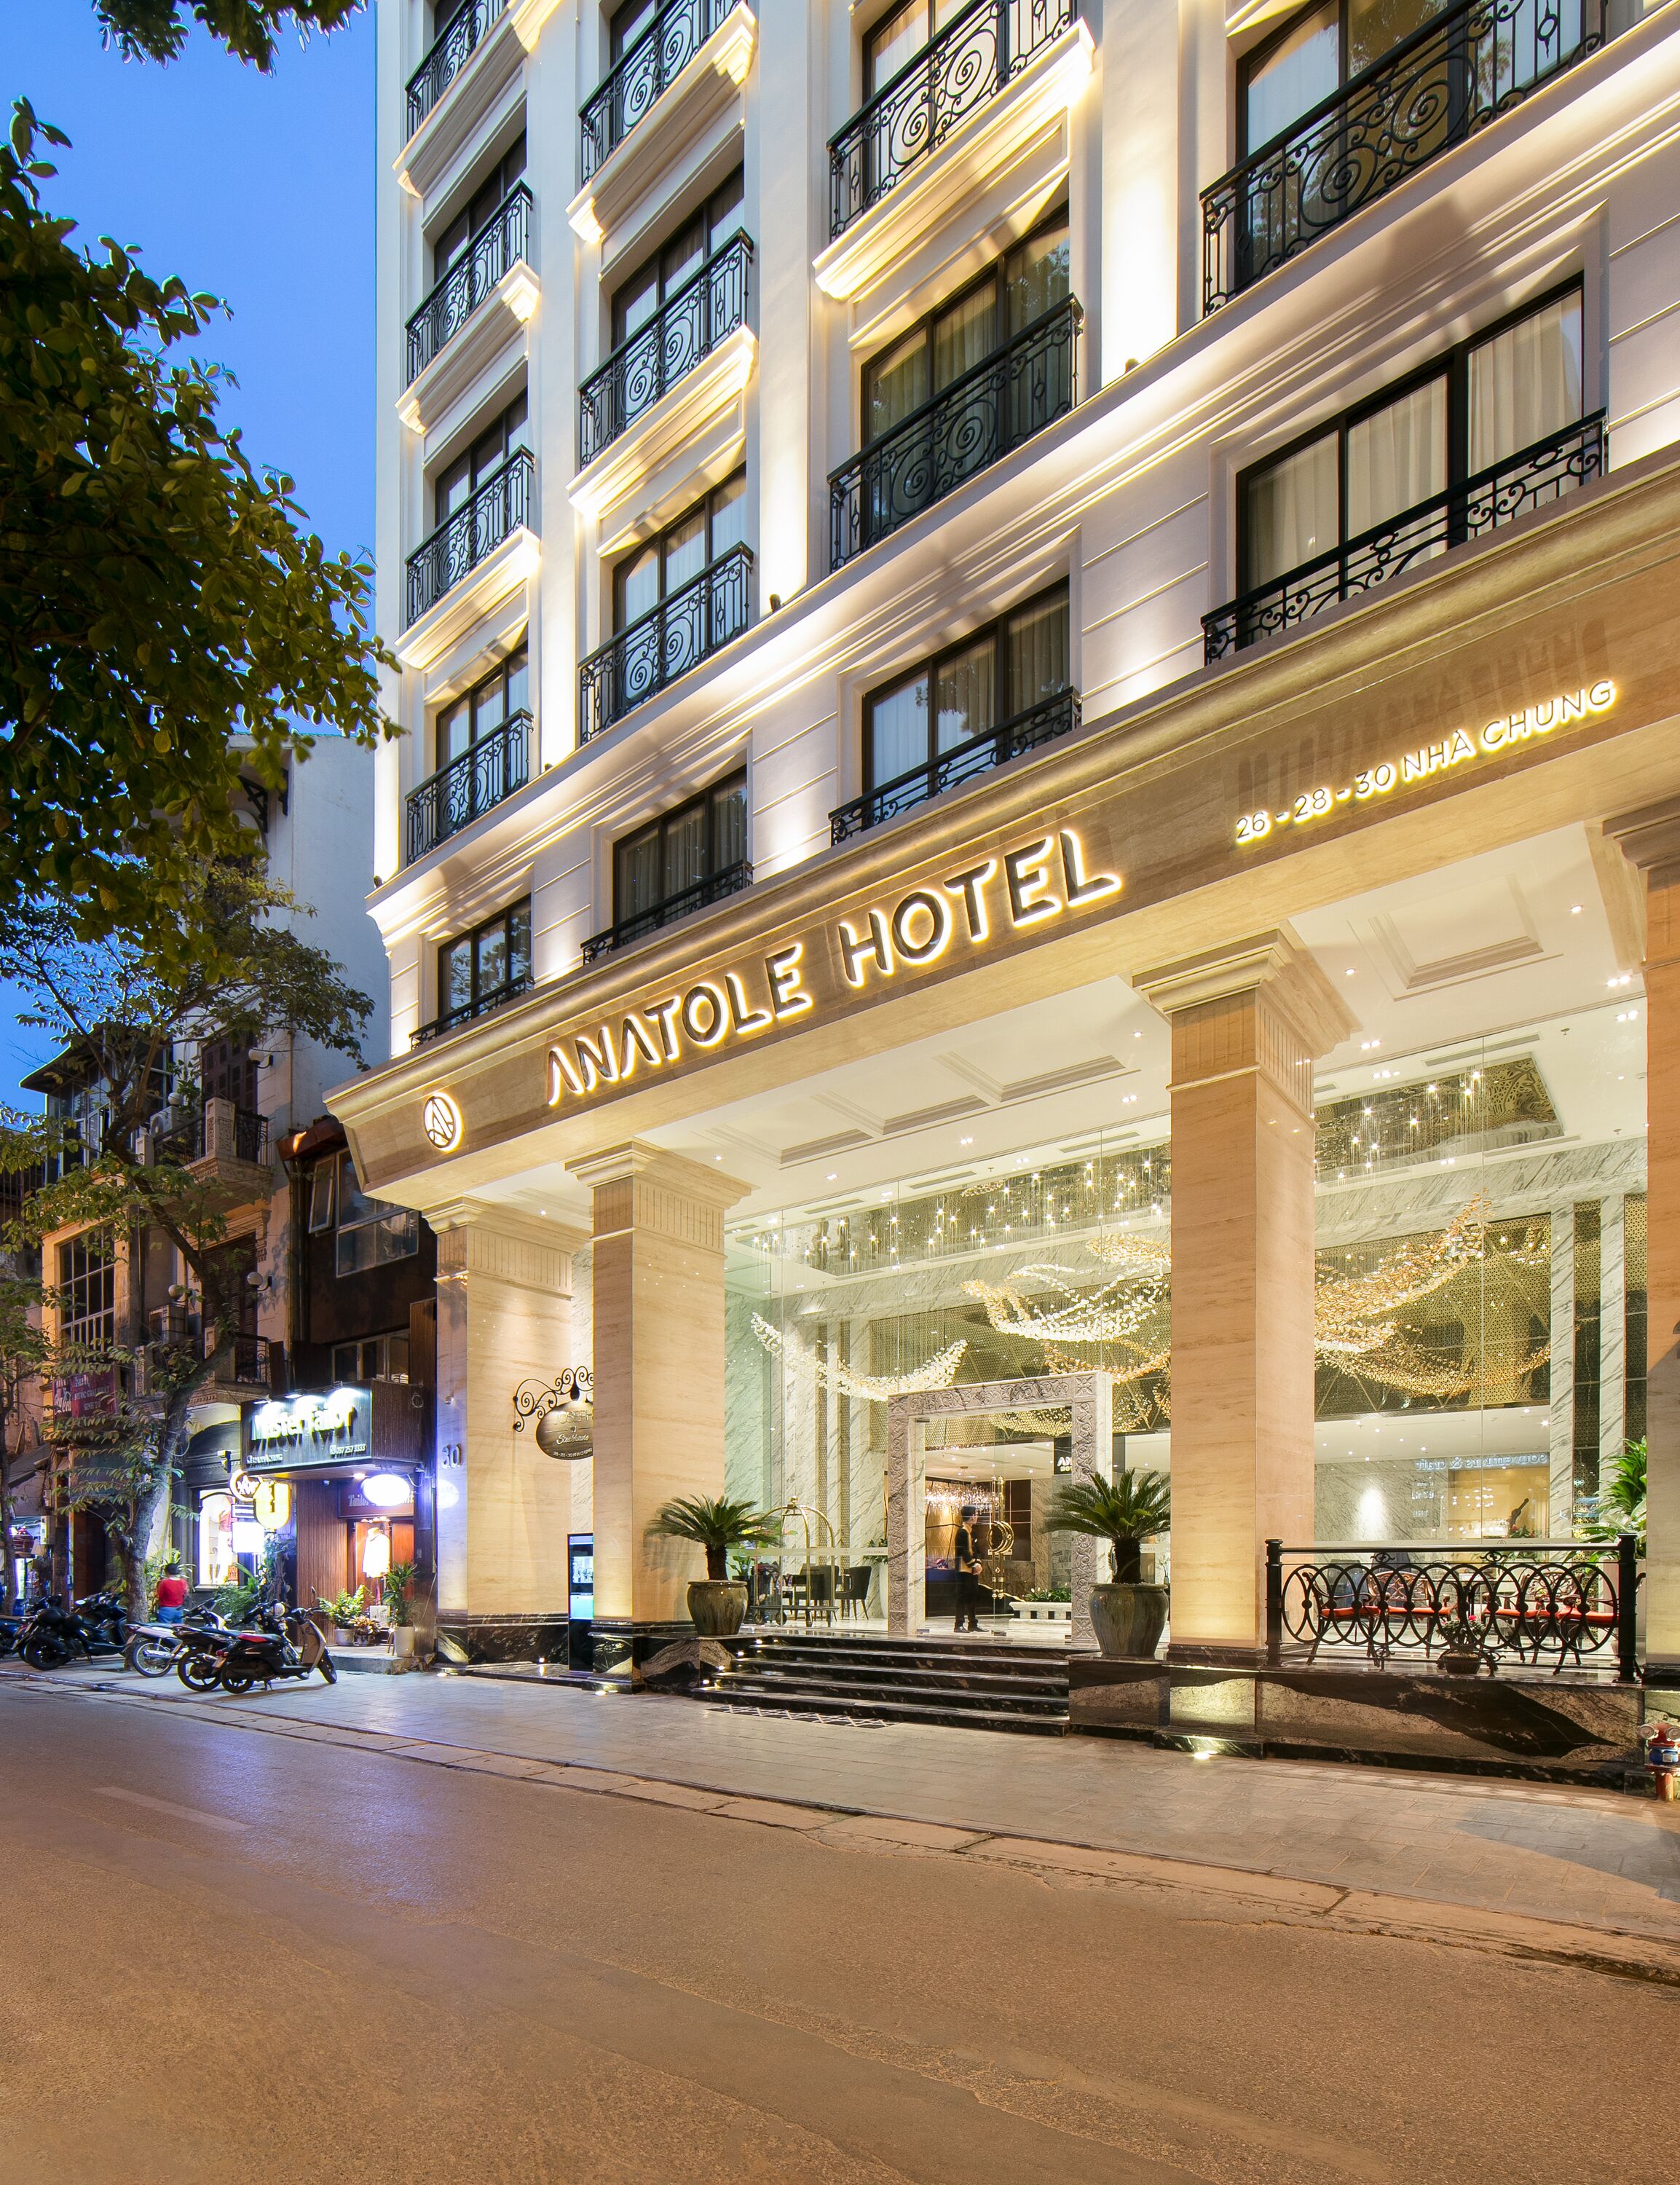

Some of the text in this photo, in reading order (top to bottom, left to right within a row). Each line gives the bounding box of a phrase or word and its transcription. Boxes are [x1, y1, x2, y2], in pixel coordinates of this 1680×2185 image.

[1403, 729, 1476, 779] NHÀ
[1482, 679, 1617, 751] CHUNG
[548, 829, 1123, 1107] ANATOLE HOTEL
[441, 1444, 462, 1469] 30
